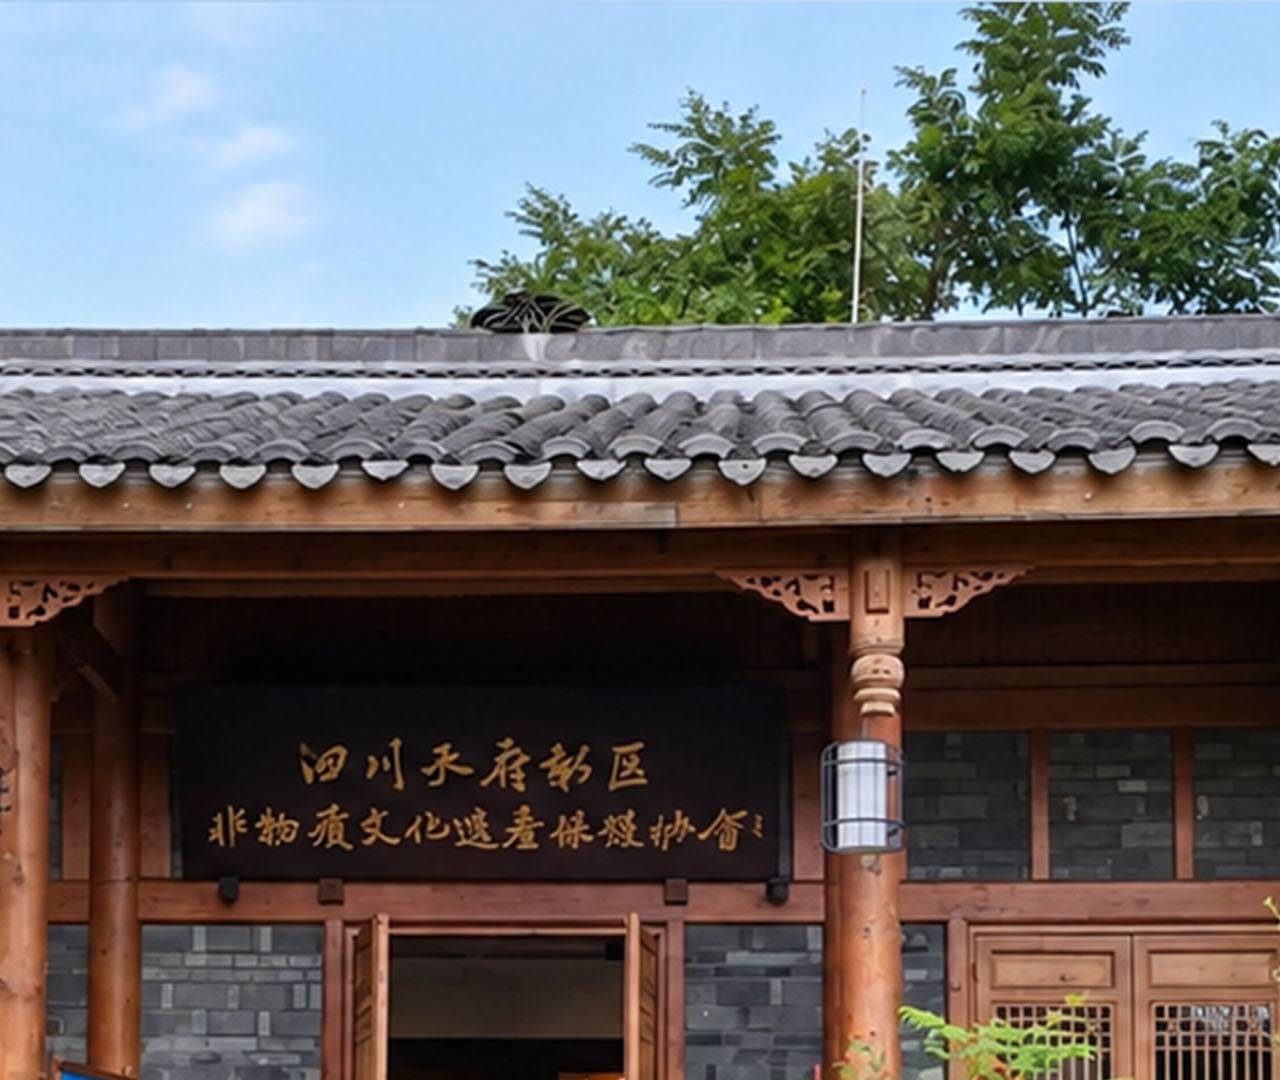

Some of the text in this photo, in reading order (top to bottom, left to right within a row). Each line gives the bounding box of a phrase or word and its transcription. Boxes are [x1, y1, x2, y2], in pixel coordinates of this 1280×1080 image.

[300, 737, 649, 792] 四川天府新区
